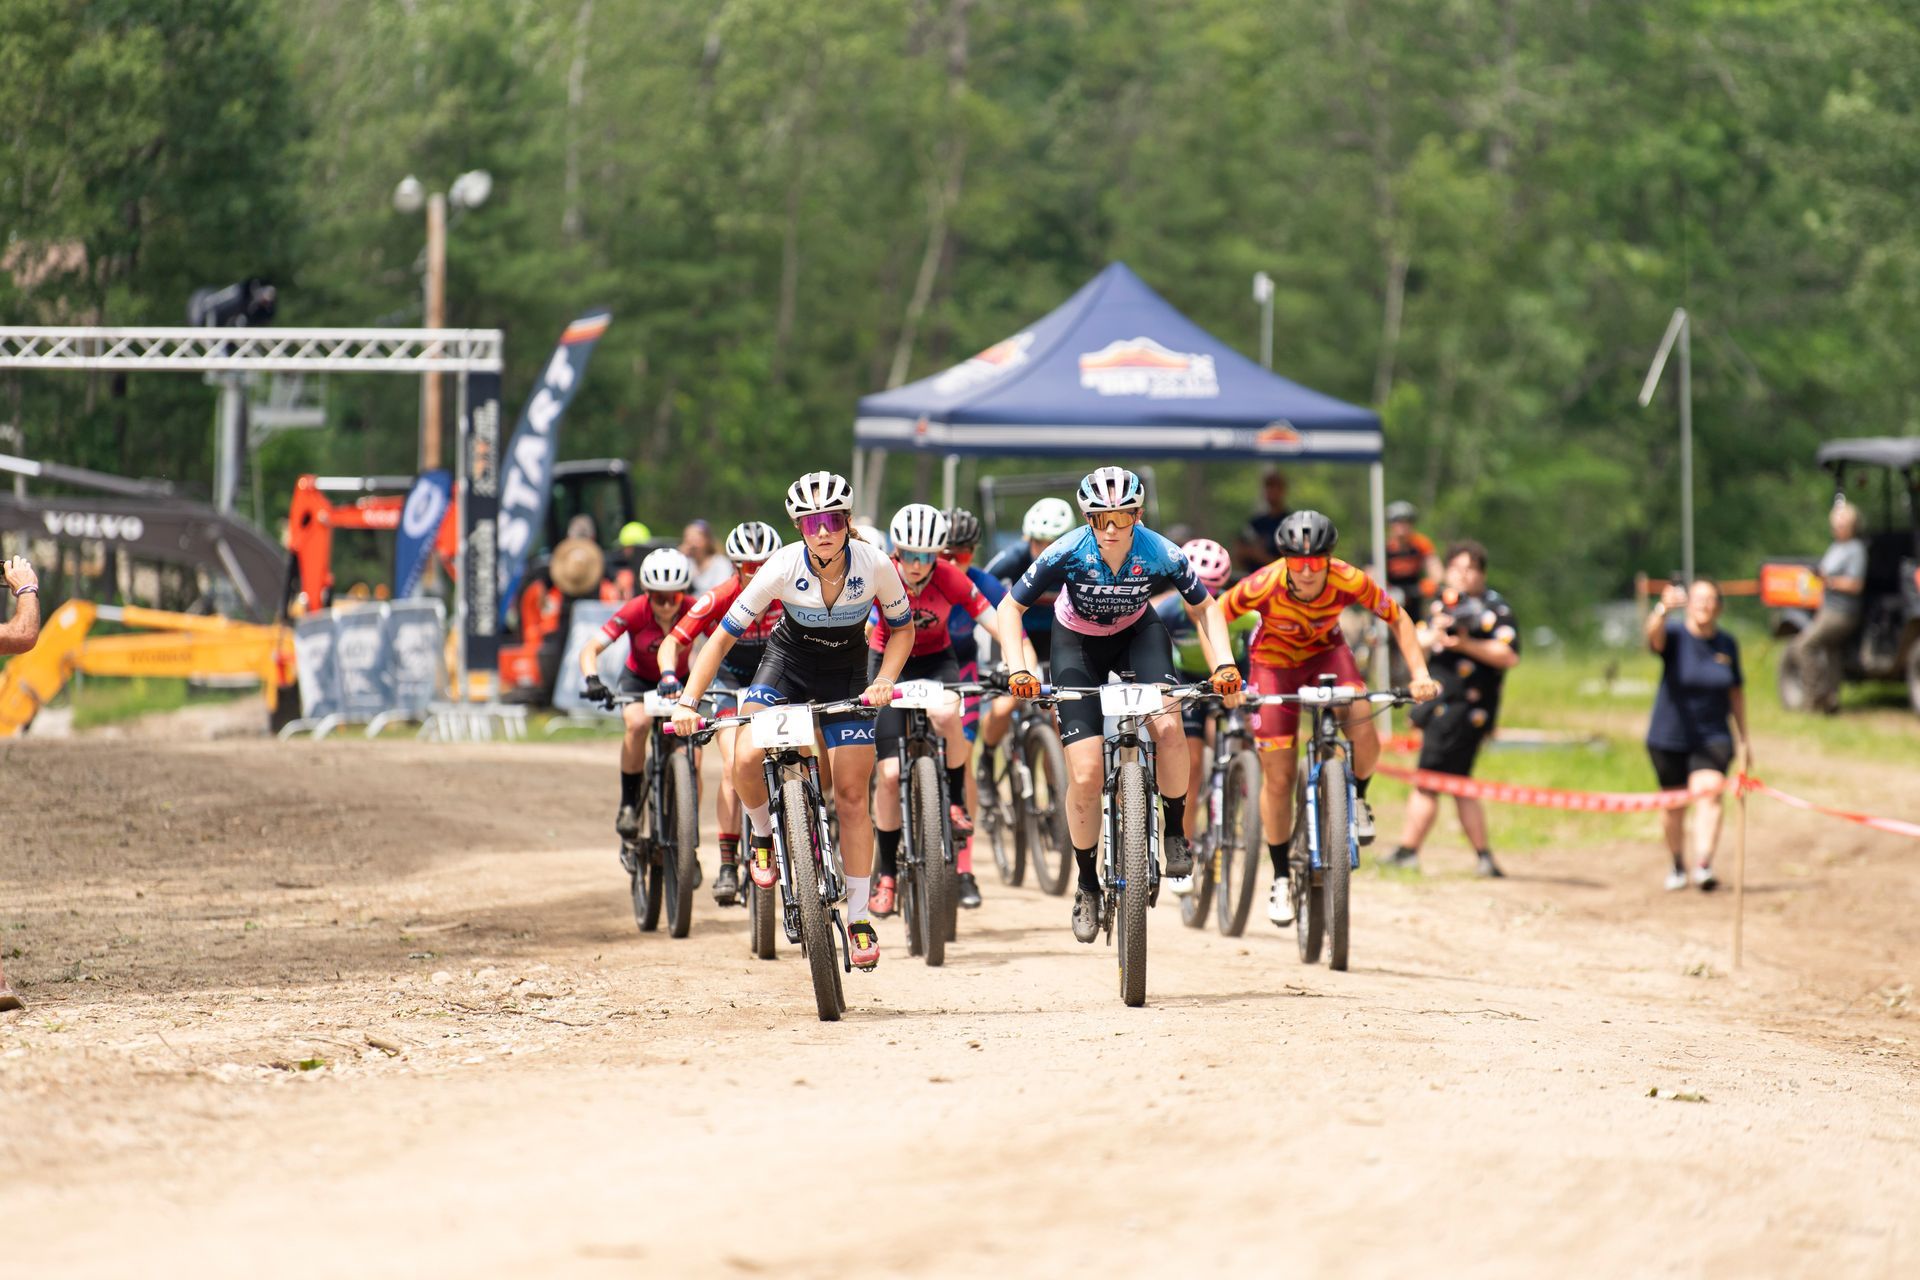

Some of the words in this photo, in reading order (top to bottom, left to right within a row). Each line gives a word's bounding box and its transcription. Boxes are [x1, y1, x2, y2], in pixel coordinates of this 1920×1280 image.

[44, 510, 144, 542] VOLVO
[1075, 583, 1152, 595] TREK
[797, 610, 828, 623] ncc
[906, 683, 928, 698] 25
[1120, 687, 1143, 706] 17
[776, 712, 789, 735] 2
